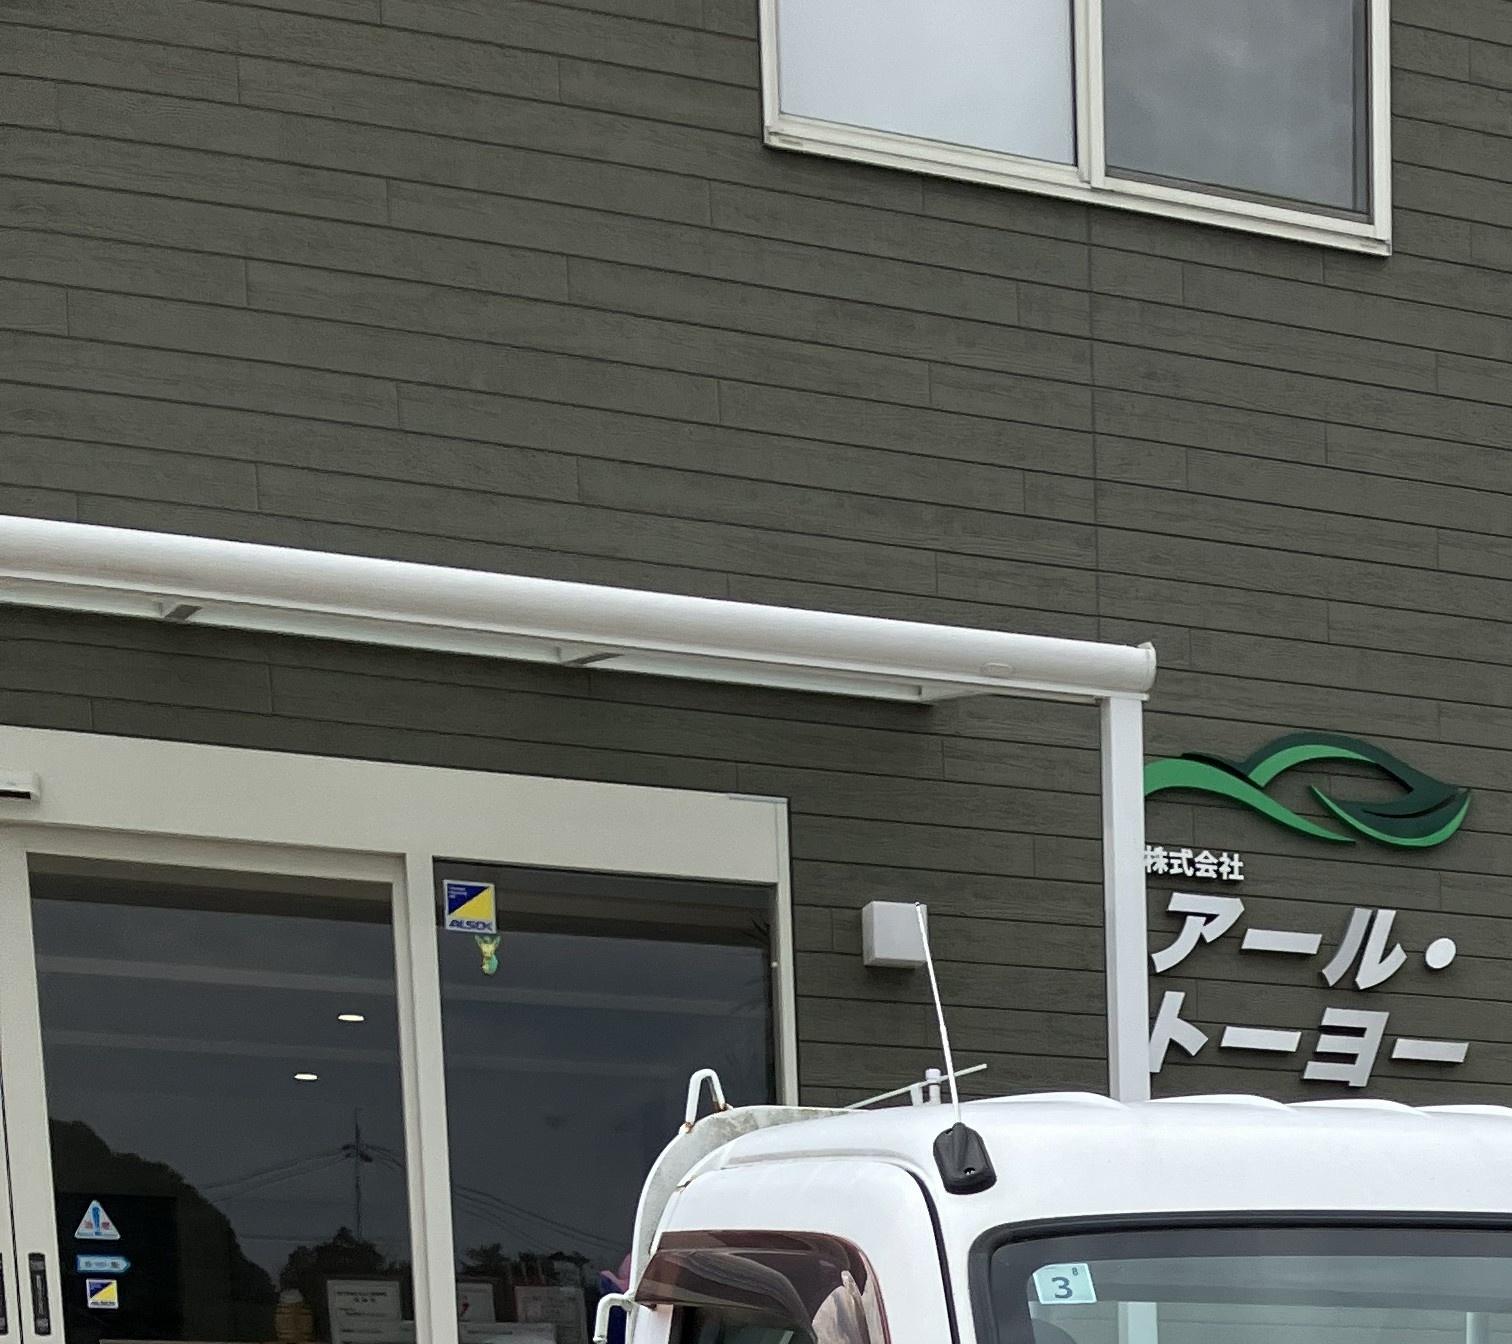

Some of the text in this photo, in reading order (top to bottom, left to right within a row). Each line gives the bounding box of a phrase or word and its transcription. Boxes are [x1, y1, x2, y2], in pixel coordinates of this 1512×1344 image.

[1144, 845, 1245, 880] 株式会社
[1150, 892, 1457, 991] アール・
[1149, 990, 1470, 1087] トーヨー
[1051, 1276, 1073, 1299] 3
